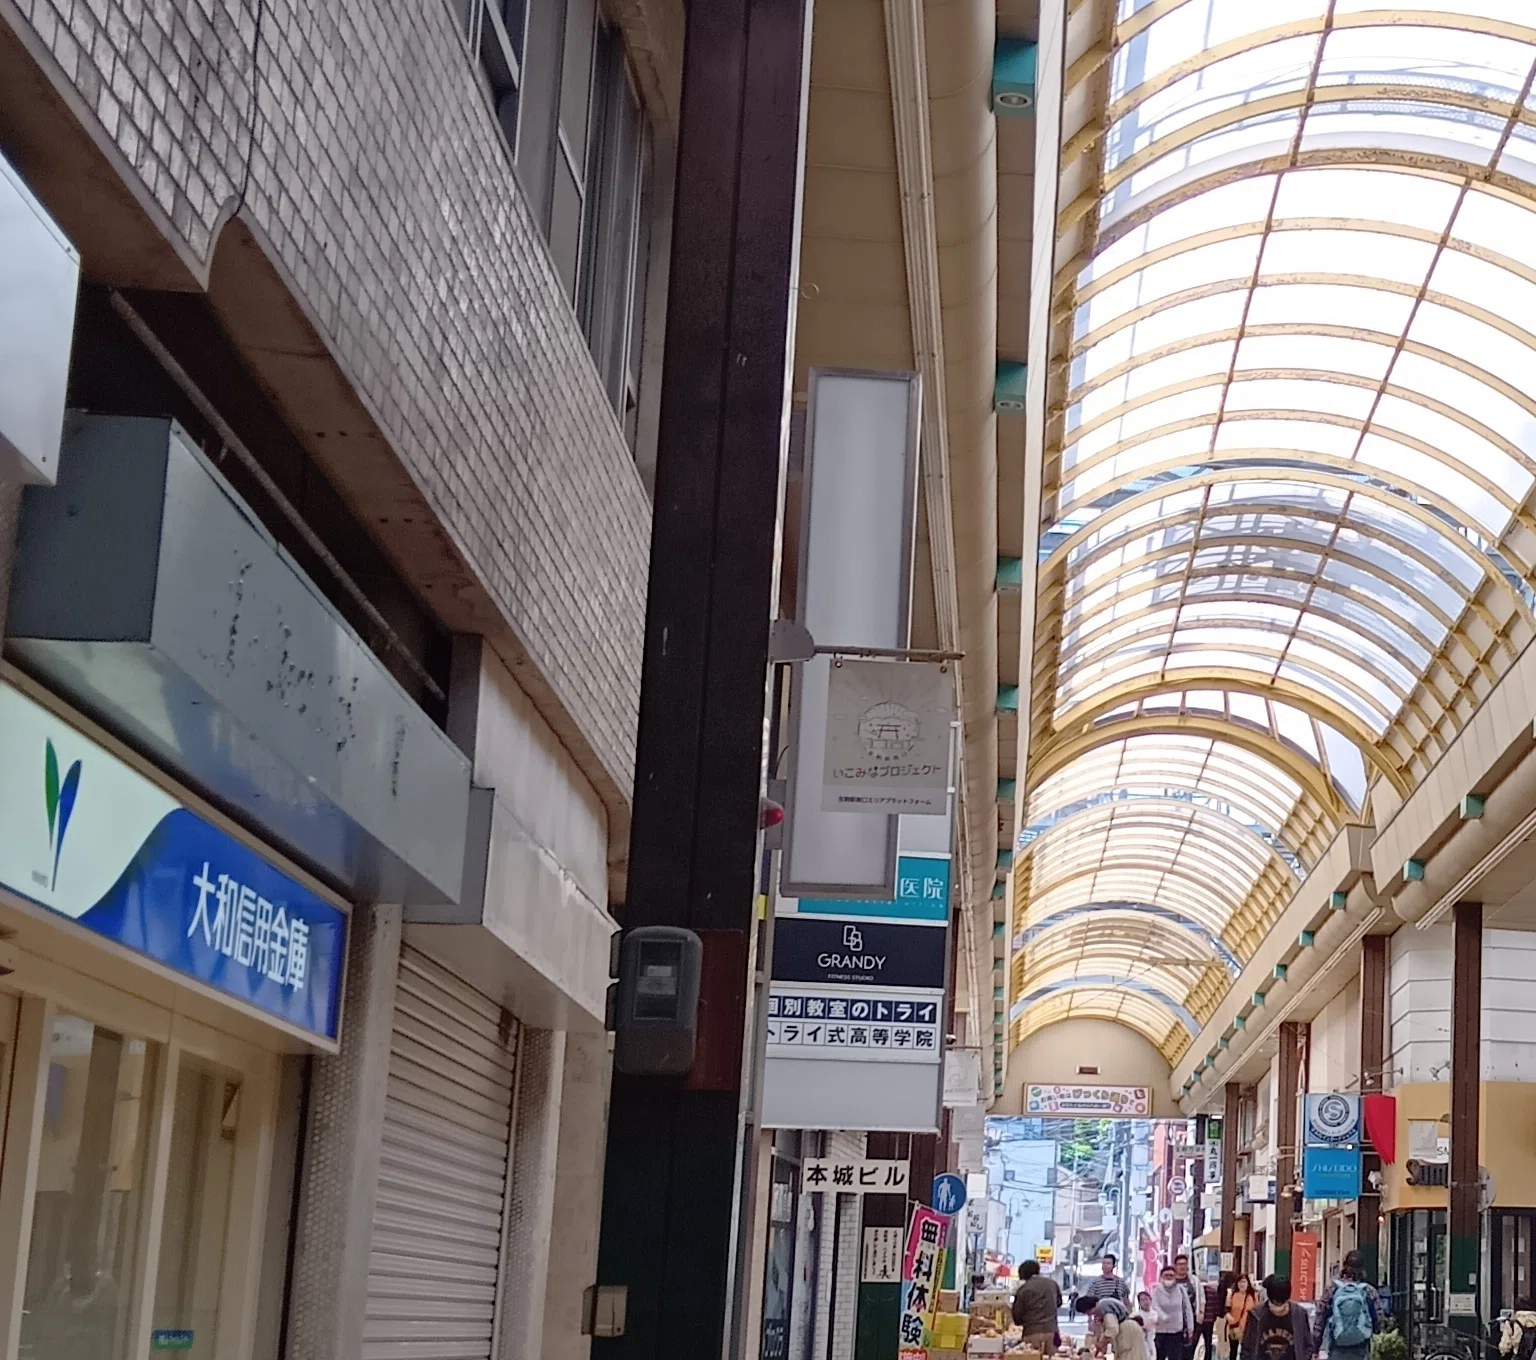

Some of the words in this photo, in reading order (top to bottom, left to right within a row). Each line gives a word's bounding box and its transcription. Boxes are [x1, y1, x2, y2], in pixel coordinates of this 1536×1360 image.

[833, 764, 941, 778] いこみなプロジェクト
[900, 877, 944, 900] 医院
[187, 861, 309, 992] 大和信用金庫
[817, 953, 886, 970] GRANDY
[806, 1164, 905, 1186] 本城ビル
[901, 1219, 939, 1346] 無料体験
